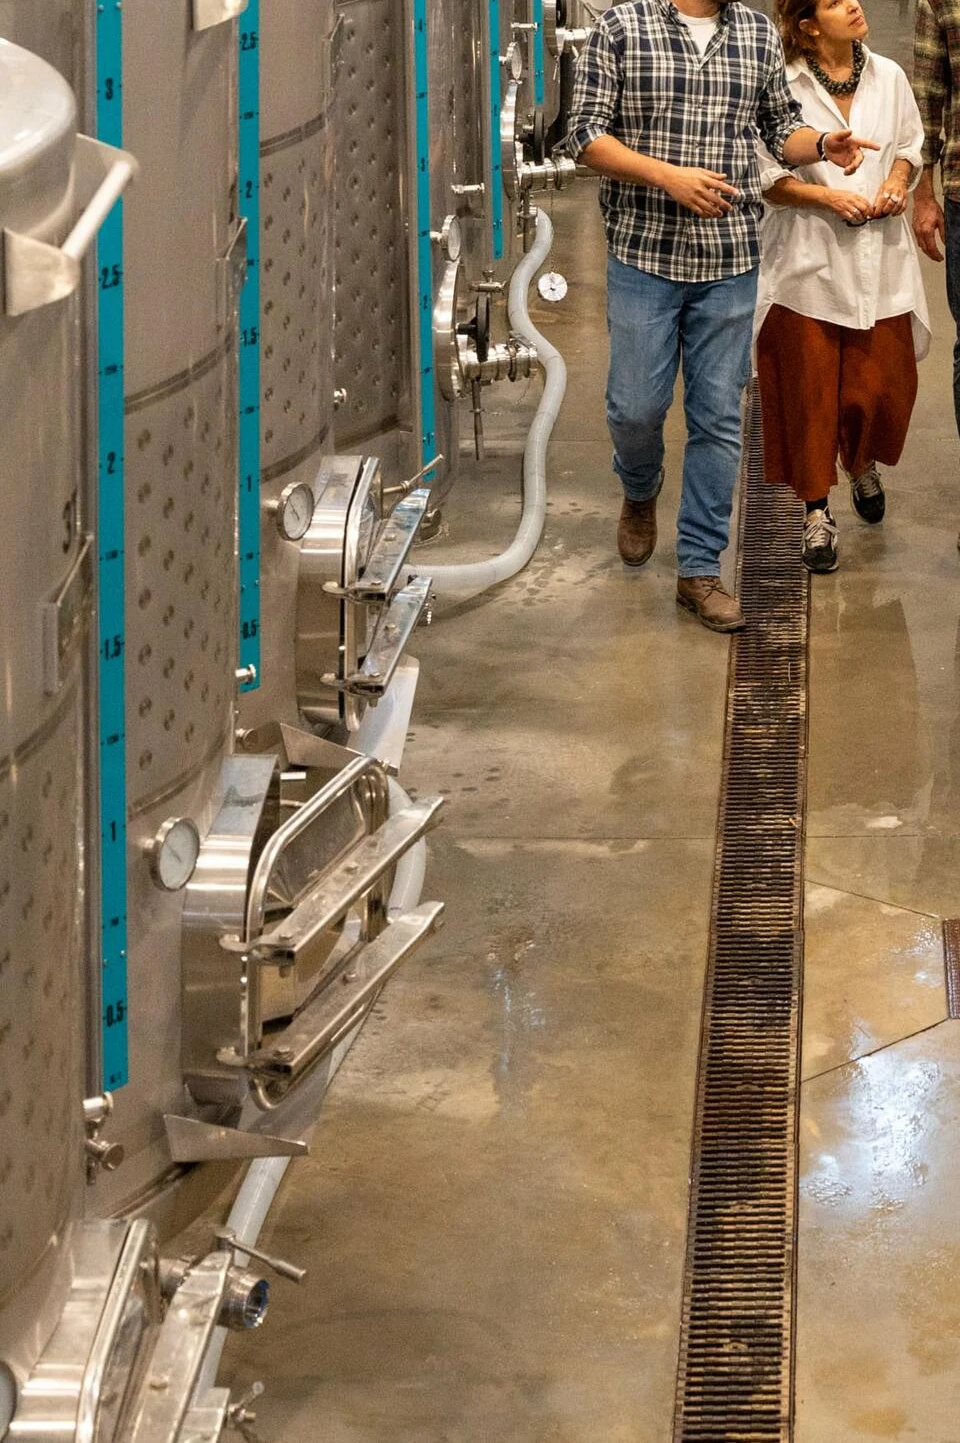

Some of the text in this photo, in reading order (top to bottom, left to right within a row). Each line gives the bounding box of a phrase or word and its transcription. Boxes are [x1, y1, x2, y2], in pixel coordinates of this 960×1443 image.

[241, 31, 256, 51] 2.5
[105, 77, 114, 101] 3
[245, 180, 253, 200] 2
[102, 264, 120, 289] 2.5
[243, 326, 257, 348] 1.5
[107, 451, 116, 476] 2
[104, 634, 121, 661] 1.5
[110, 820, 117, 843] 1
[105, 999, 124, 1028] 0.5
